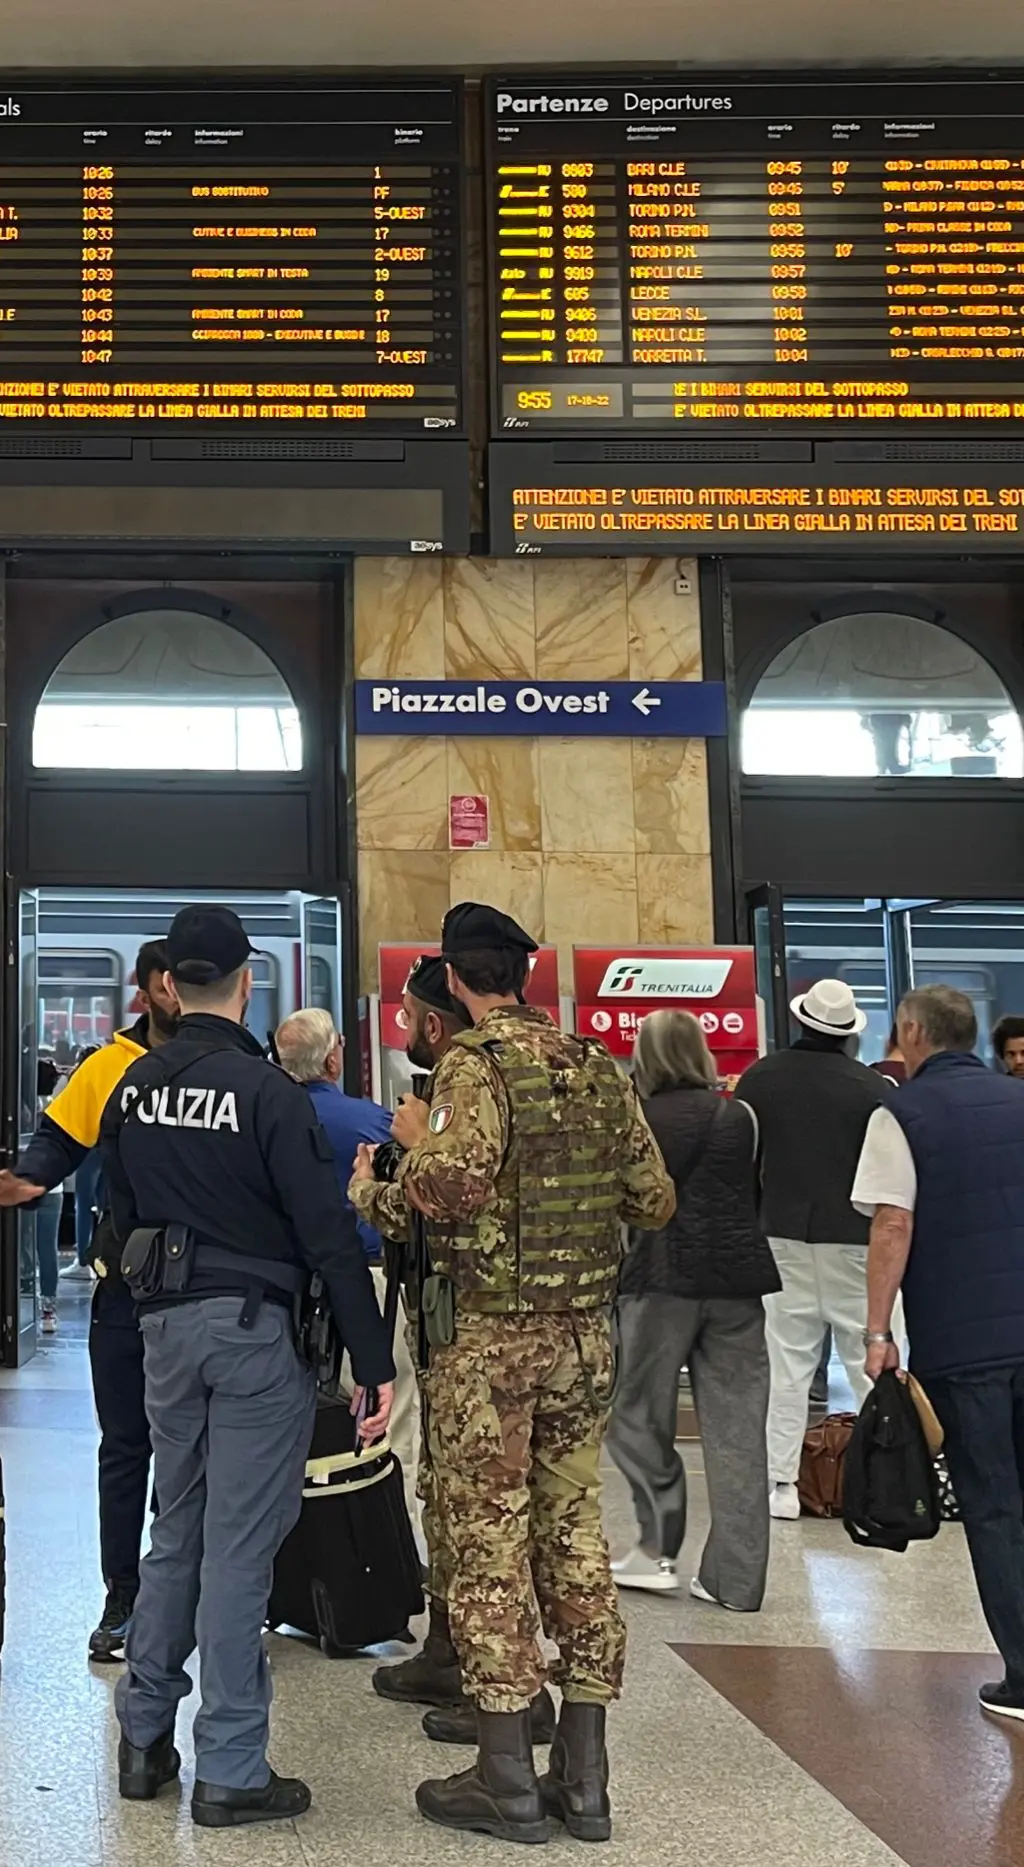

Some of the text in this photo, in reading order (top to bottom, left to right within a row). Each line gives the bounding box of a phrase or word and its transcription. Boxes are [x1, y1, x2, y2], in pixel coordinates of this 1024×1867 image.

[497, 93, 732, 114] Partenze Departures
[375, 187, 389, 198] PF
[376, 228, 389, 238] 17
[375, 248, 423, 260] 2-OVEST
[376, 270, 389, 280] 19
[376, 310, 389, 321] 17
[632, 307, 683, 320] VENEZIA
[377, 330, 389, 343] 18
[378, 351, 426, 364] 7-OVEST
[633, 349, 695, 362] PORRETTA
[518, 392, 551, 408] 9:55
[48, 404, 135, 417] OLTREPASSARE
[139, 405, 155, 417] LA
[158, 404, 193, 417] LINEA
[197, 405, 239, 417] GIALLA
[260, 405, 304, 417] ATTESA
[307, 405, 328, 417] DEI
[513, 489, 607, 505] ATTENZIONE!
[631, 489, 693, 505] VIETATO
[699, 489, 810, 505] ATTRAVERSARE
[816, 489, 823, 505] I
[829, 489, 881, 505] BINARI
[887, 489, 958, 505] SERVIRSI
[964, 490, 993, 505] DEL
[533, 513, 595, 529] VIETATO
[601, 513, 713, 529] OLTREPASSARE
[718, 514, 738, 529] LA
[744, 514, 789, 530] LINEA
[794, 514, 850, 530] GIALLA
[855, 514, 872, 530] IN
[878, 514, 934, 531] ATTESA
[940, 514, 967, 531] DEI
[972, 514, 1017, 531] TRENI
[372, 687, 610, 714] Piazzale Ovest
[641, 983, 713, 993] TRENITALIA
[122, 1084, 240, 1133] POLIZIA
